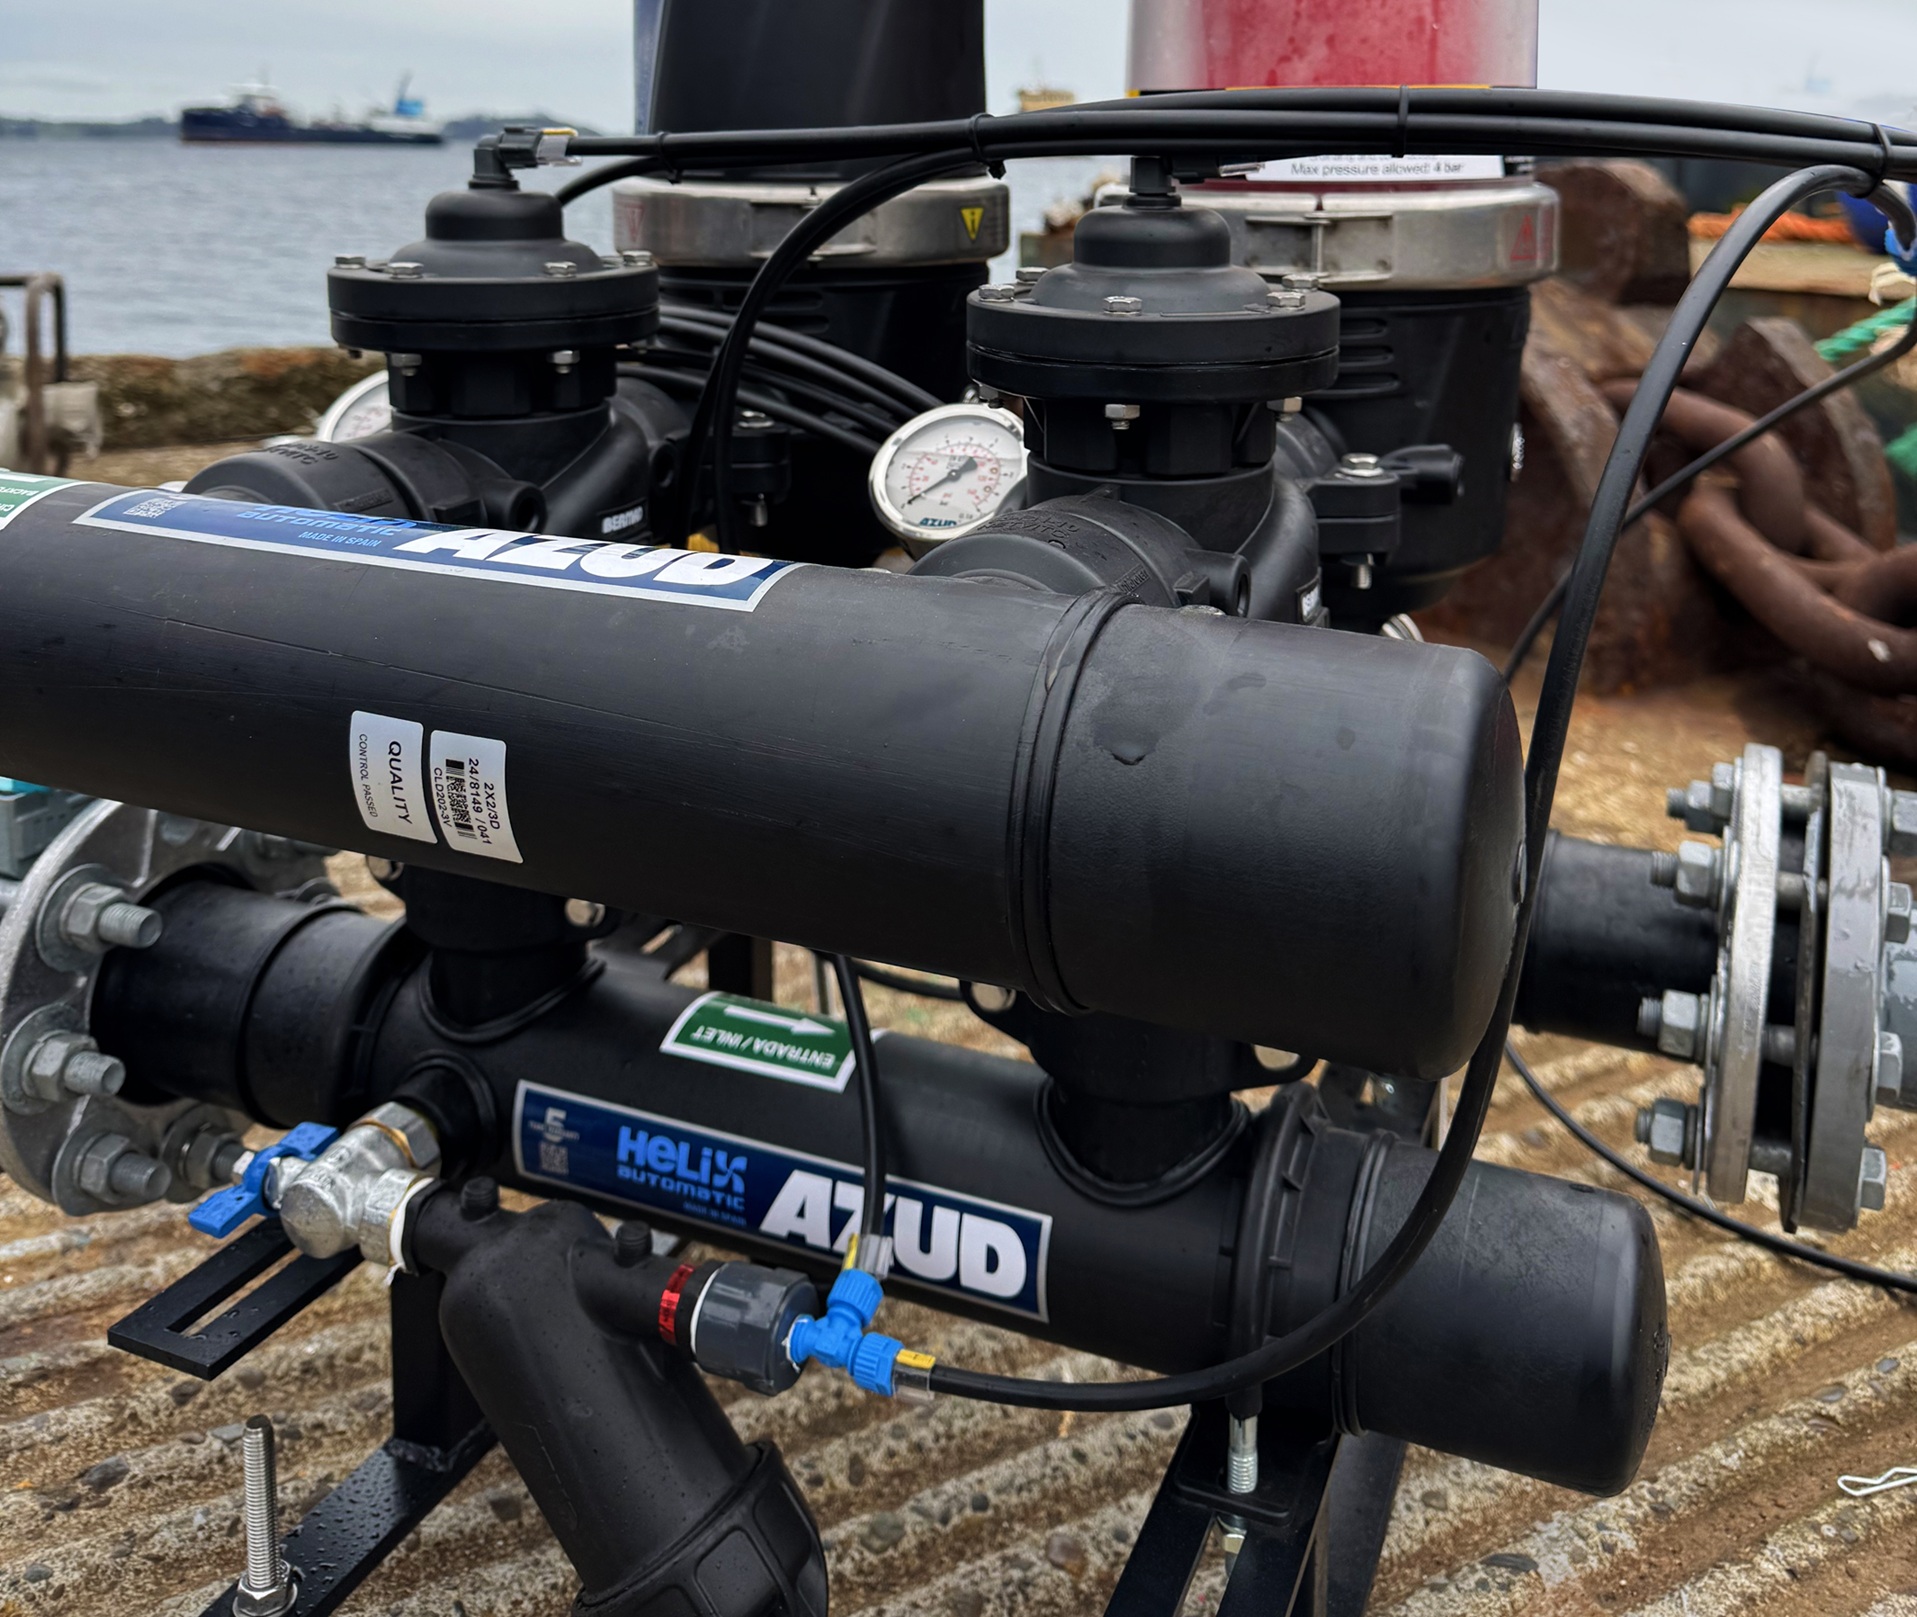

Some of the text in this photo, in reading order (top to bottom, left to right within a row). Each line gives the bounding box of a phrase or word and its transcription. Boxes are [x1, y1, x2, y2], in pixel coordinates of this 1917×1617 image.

[1291, 163, 1318, 175] Max
[1322, 165, 1379, 176] pressure
[1444, 162, 1464, 173] bar
[298, 531, 383, 548] MADE IN SPAIN
[392, 528, 774, 586] AZUD
[359, 733, 378, 818] CONTROL PASSED
[388, 740, 412, 825] QUALITY
[434, 767, 452, 828] CLD202-3V
[469, 757, 483, 814] 24/8149
[484, 782, 501, 830] 2X2/3D
[691, 1024, 744, 1050] INLET
[751, 1036, 836, 1070] ENTRADA
[759, 1169, 1027, 1298] AZUD
